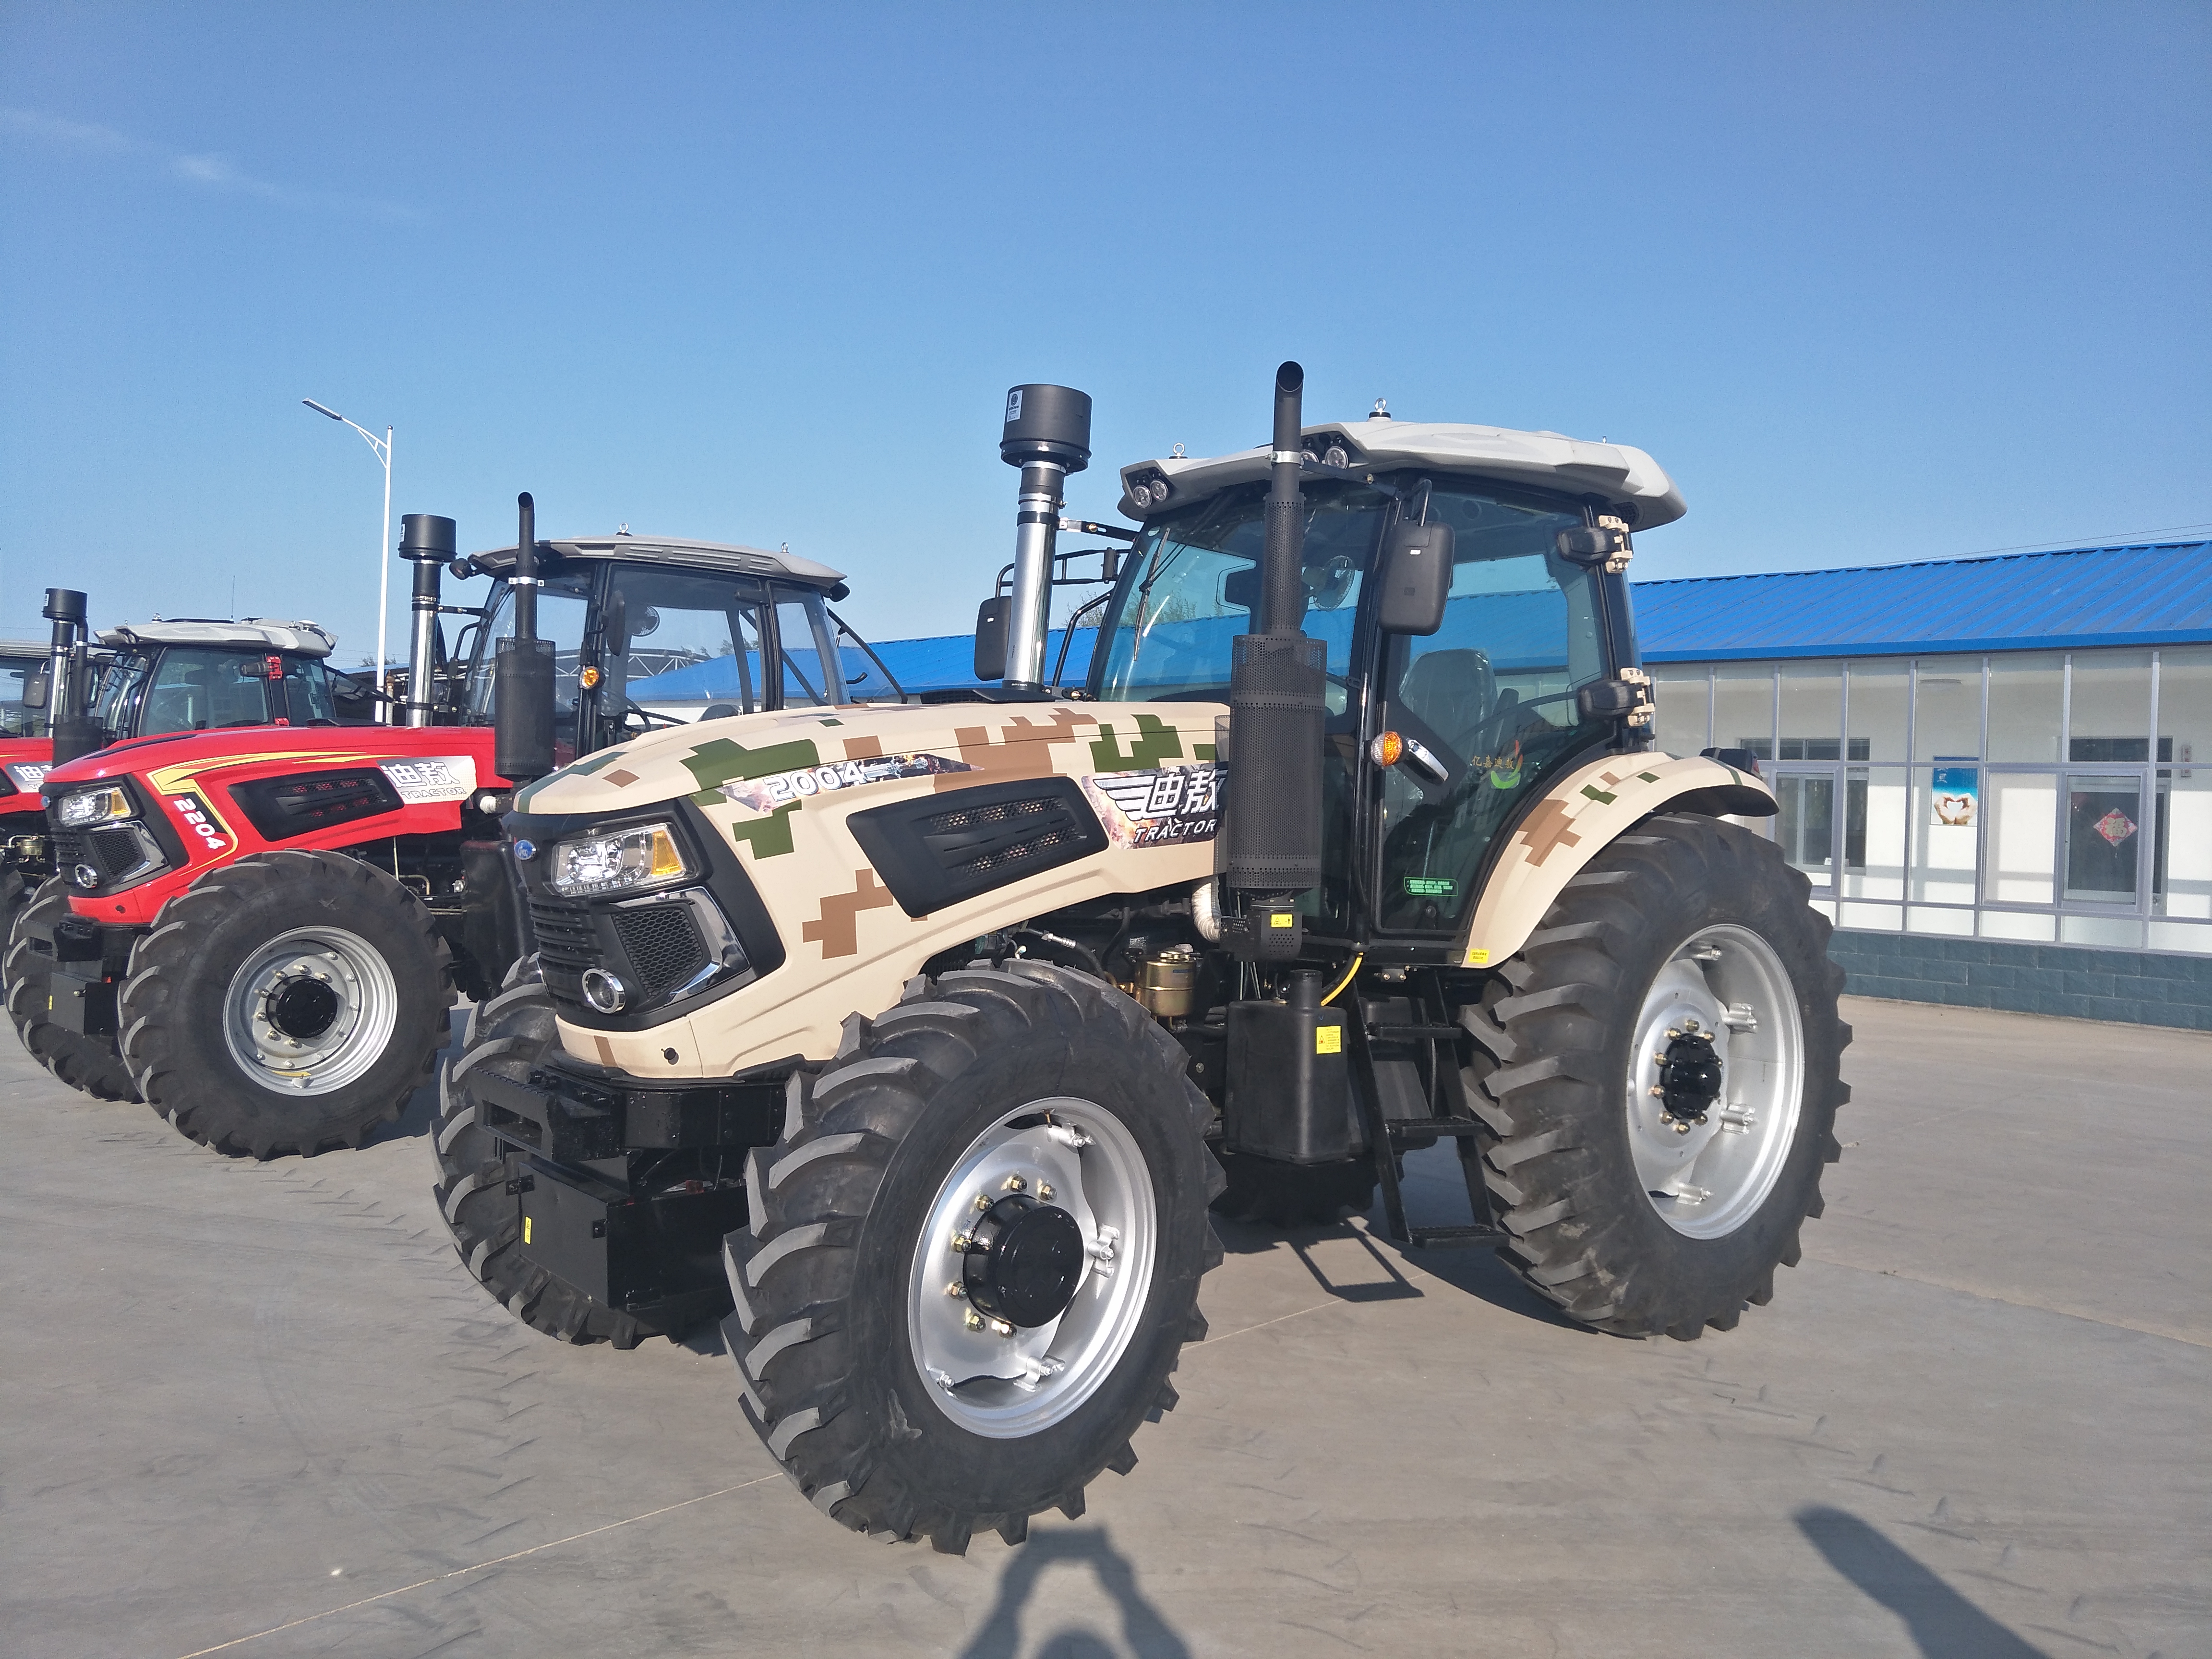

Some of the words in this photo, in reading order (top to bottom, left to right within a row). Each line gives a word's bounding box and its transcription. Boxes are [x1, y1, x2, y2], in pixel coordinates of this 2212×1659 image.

[380, 762, 460, 788] 迪敖
[763, 761, 868, 802] 2004
[401, 787, 467, 798] TRACTOR
[174, 798, 226, 849] 2204
[1134, 818, 1218, 843] TRACTOR
[2104, 817, 2127, 837] 福
